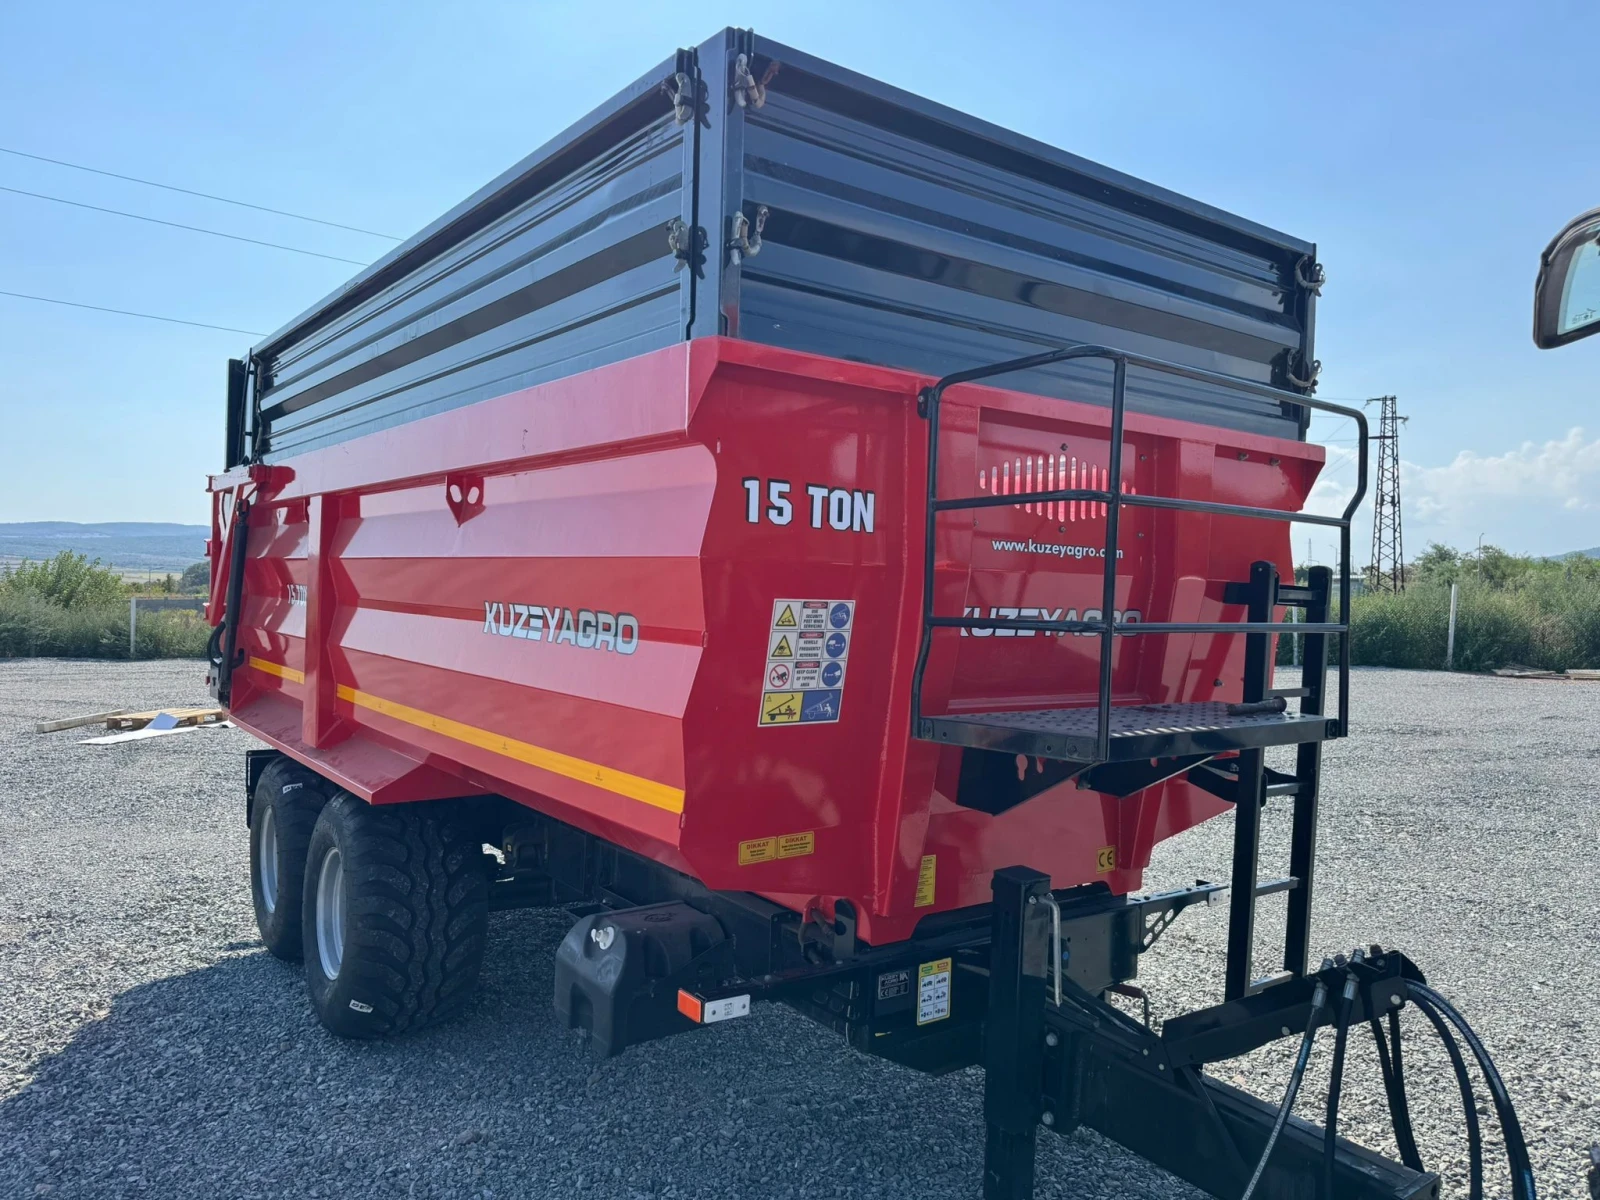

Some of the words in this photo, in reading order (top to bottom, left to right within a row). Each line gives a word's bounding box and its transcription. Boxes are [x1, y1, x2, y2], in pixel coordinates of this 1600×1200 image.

[742, 476, 793, 526] 15
[806, 483, 875, 533] TON
[992, 538, 1123, 560] www.kuzeyagro.cm
[483, 600, 639, 655] KUZEYAGRO
